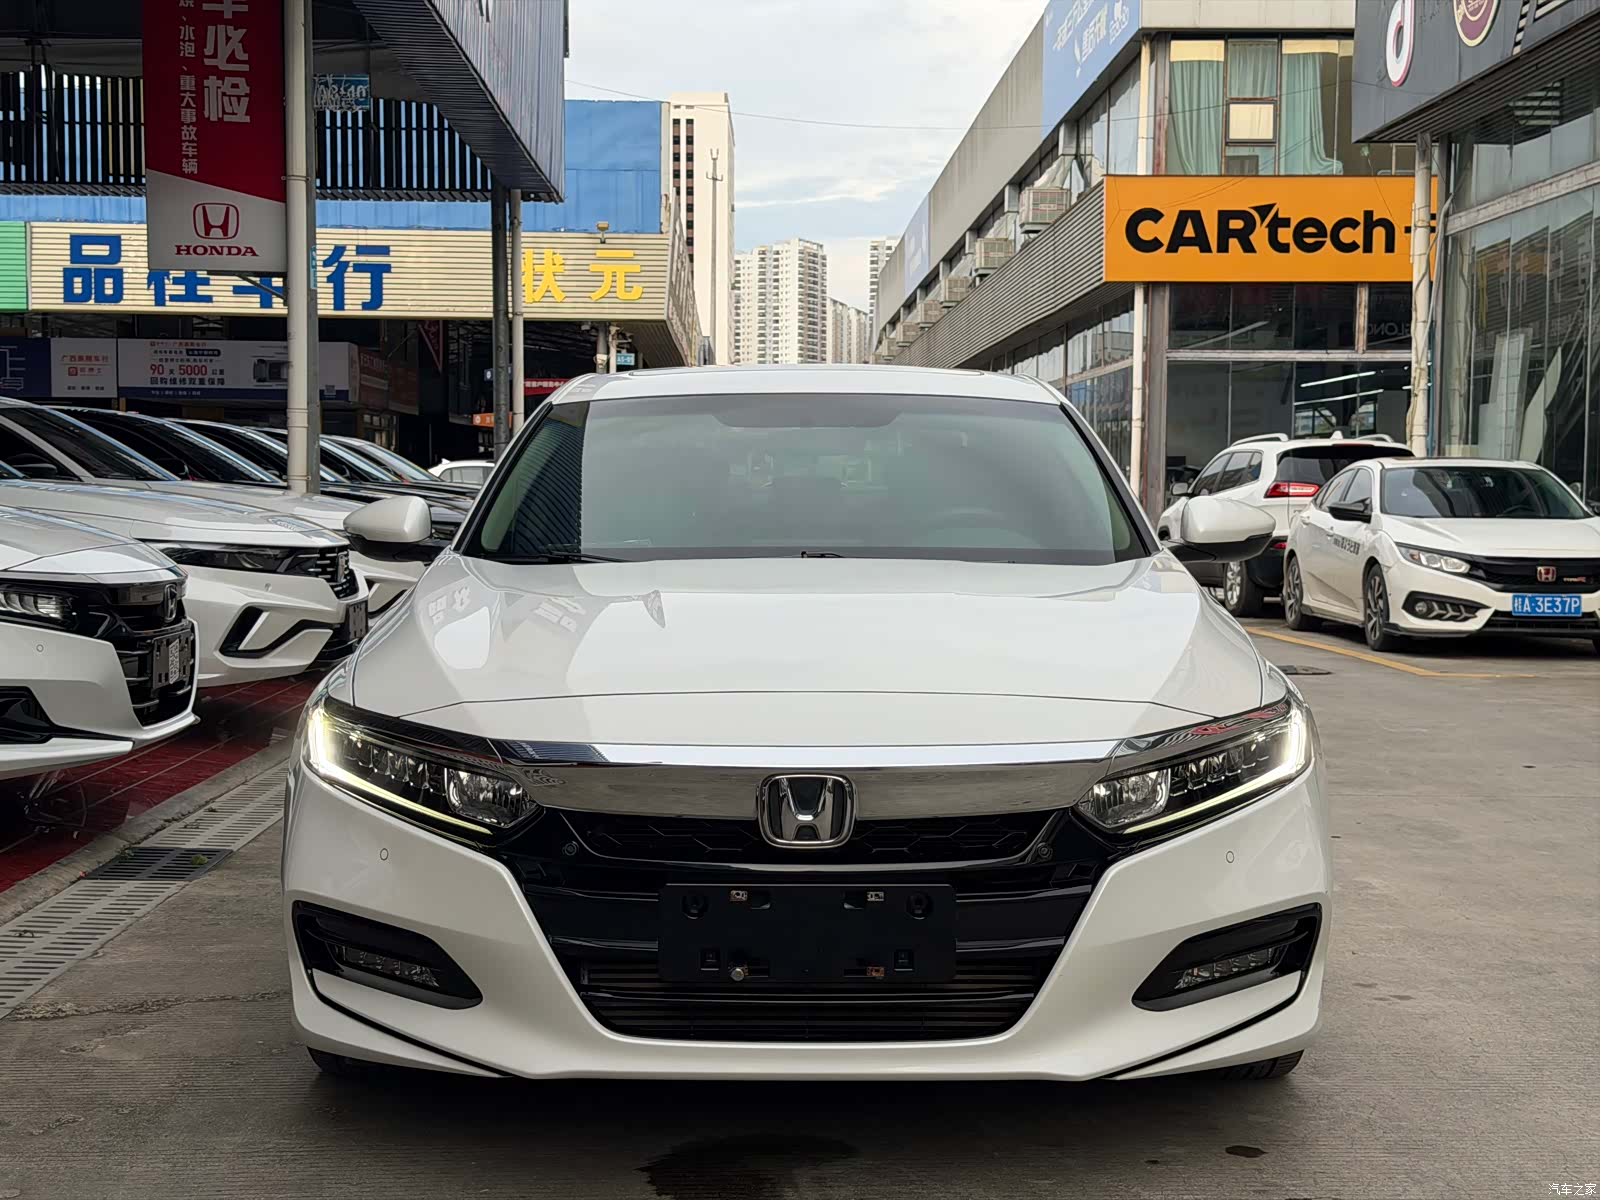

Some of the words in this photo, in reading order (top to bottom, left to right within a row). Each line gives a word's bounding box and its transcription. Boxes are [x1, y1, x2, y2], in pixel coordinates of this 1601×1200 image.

[175, 245, 259, 257] HONDA
[521, 249, 644, 304] 状元
[150, 364, 164, 375] 90
[179, 364, 208, 376] 5000
